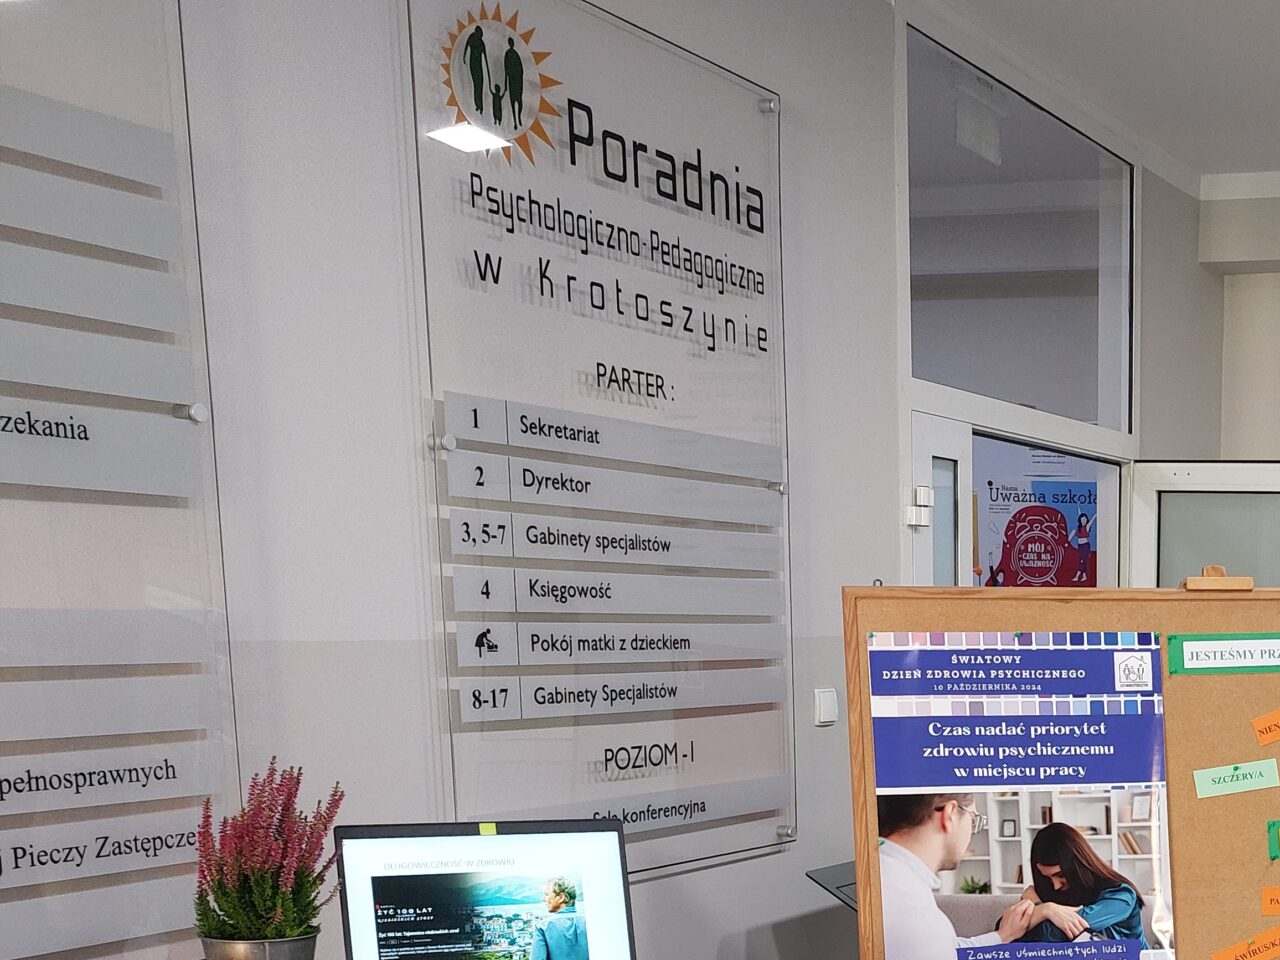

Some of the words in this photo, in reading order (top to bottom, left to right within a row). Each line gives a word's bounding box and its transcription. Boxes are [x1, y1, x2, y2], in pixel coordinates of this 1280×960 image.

[567, 97, 765, 234] Poradnia
[470, 172, 765, 296] Psychologiczno-Pedagogiczna
[538, 256, 768, 353] Krotoszynie
[471, 408, 480, 430] 1
[520, 415, 601, 445] Sekretariat
[474, 466, 485, 487] 2
[522, 469, 592, 499] Dyrektor
[989, 487, 1046, 503] Uważna
[481, 523, 506, 545] 5-7
[526, 526, 591, 552] Gabinety
[595, 533, 671, 556] specjalistów
[1028, 542, 1045, 552] MÓJ
[480, 580, 491, 600] 4
[529, 579, 612, 605] Księgowość
[531, 634, 573, 656] Pokój
[577, 634, 616, 652] matki
[619, 638, 627, 651] z
[631, 634, 691, 651] dzieckiem
[1188, 647, 1255, 662] JESTEŚMY
[951, 653, 1022, 664] ŚWIATOWY
[882, 668, 921, 680] DZIEŃ
[926, 669, 986, 679] ZDROWIA
[990, 669, 1086, 679] PSYCHICZNEGO
[534, 686, 597, 711] Gabinety
[602, 682, 678, 708] Specjalistów
[947, 682, 1018, 691] PAŹDZIERNIKA
[472, 689, 509, 710] 8-17
[928, 722, 971, 737] Czas
[975, 722, 1026, 736] nadać
[1030, 721, 1107, 738] priorytet
[604, 743, 679, 773] POZIOM
[923, 743, 995, 757] zdrowiu
[998, 742, 1114, 760] psychicznemu
[954, 766, 970, 777] w
[973, 764, 1036, 780] miejscu
[1039, 765, 1087, 780] pracy
[1211, 770, 1264, 786] SZCZERY/A
[622, 800, 706, 824] konferencyjna
[11, 844, 88, 869] Pieczy
[95, 825, 201, 858] Zastępcze
[466, 859, 474, 867] W
[476, 858, 515, 867] ZDROWIU
[967, 949, 1011, 960] Zawsze
[1016, 945, 1098, 959] uśmiechniętych
[1102, 944, 1127, 954] ludzi
